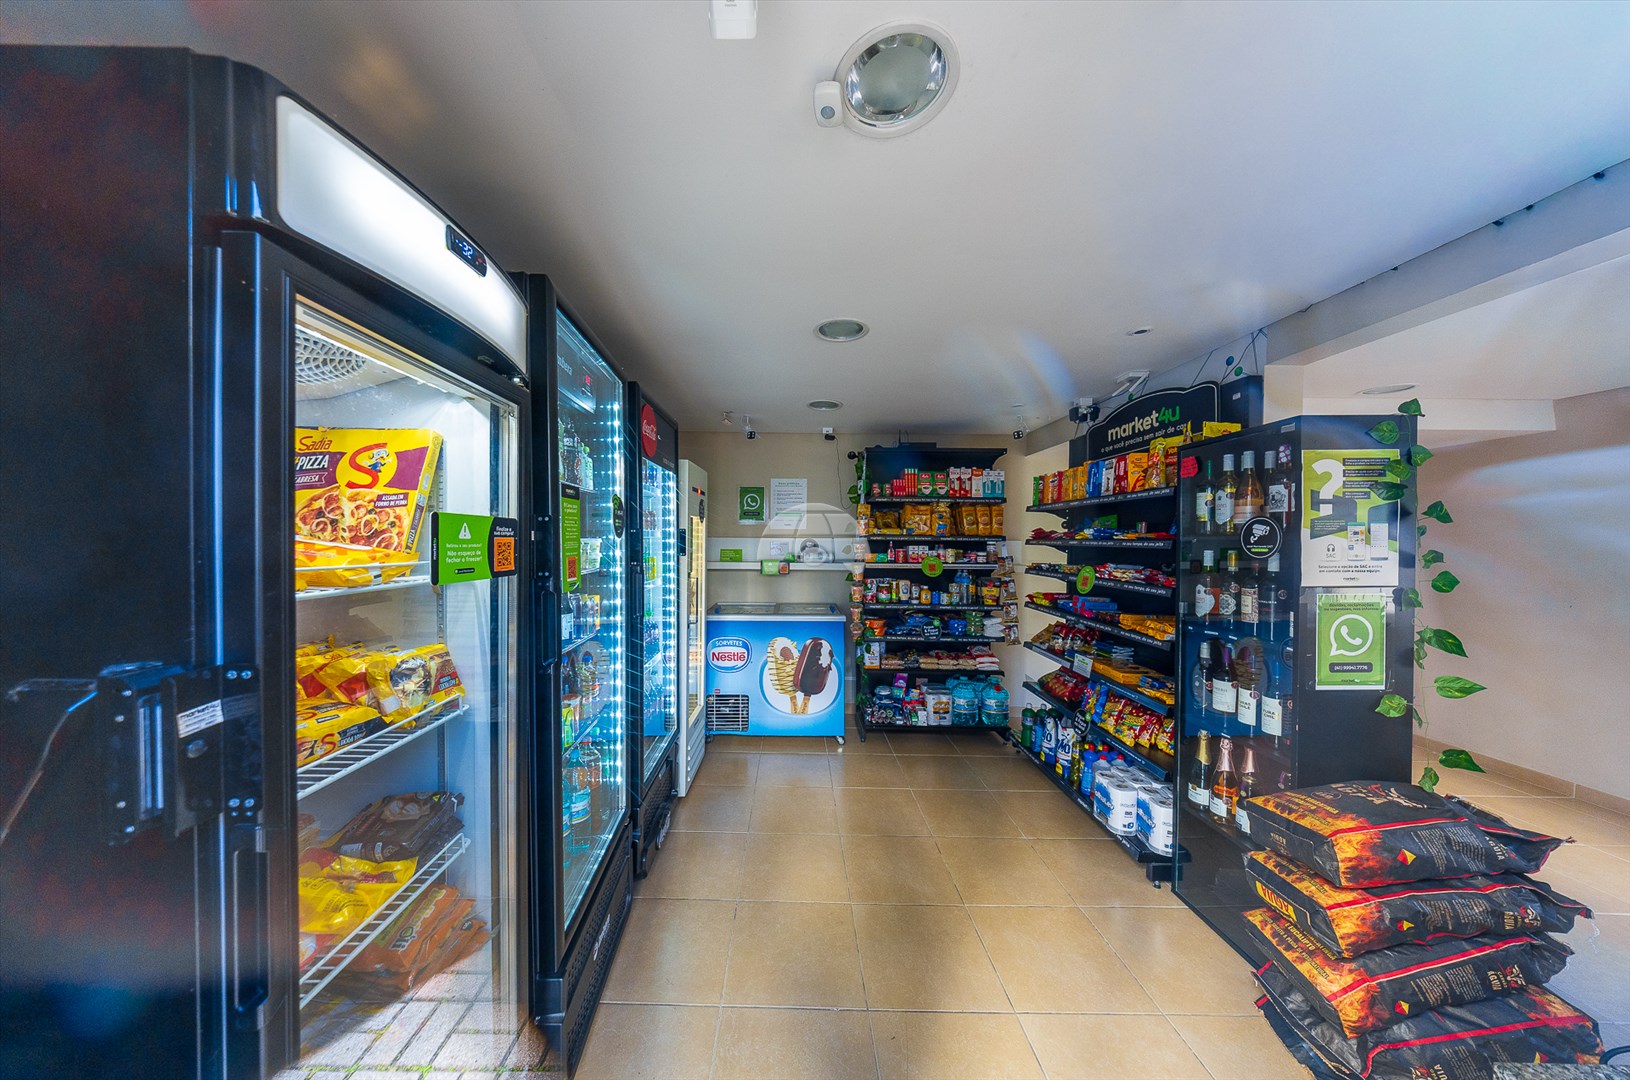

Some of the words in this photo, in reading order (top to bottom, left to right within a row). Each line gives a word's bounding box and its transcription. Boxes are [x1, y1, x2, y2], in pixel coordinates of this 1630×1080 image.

[298, 436, 333, 451] Sadia
[296, 454, 329, 471] PIZZA
[1288, 924, 1316, 951] EUCALIPTO
